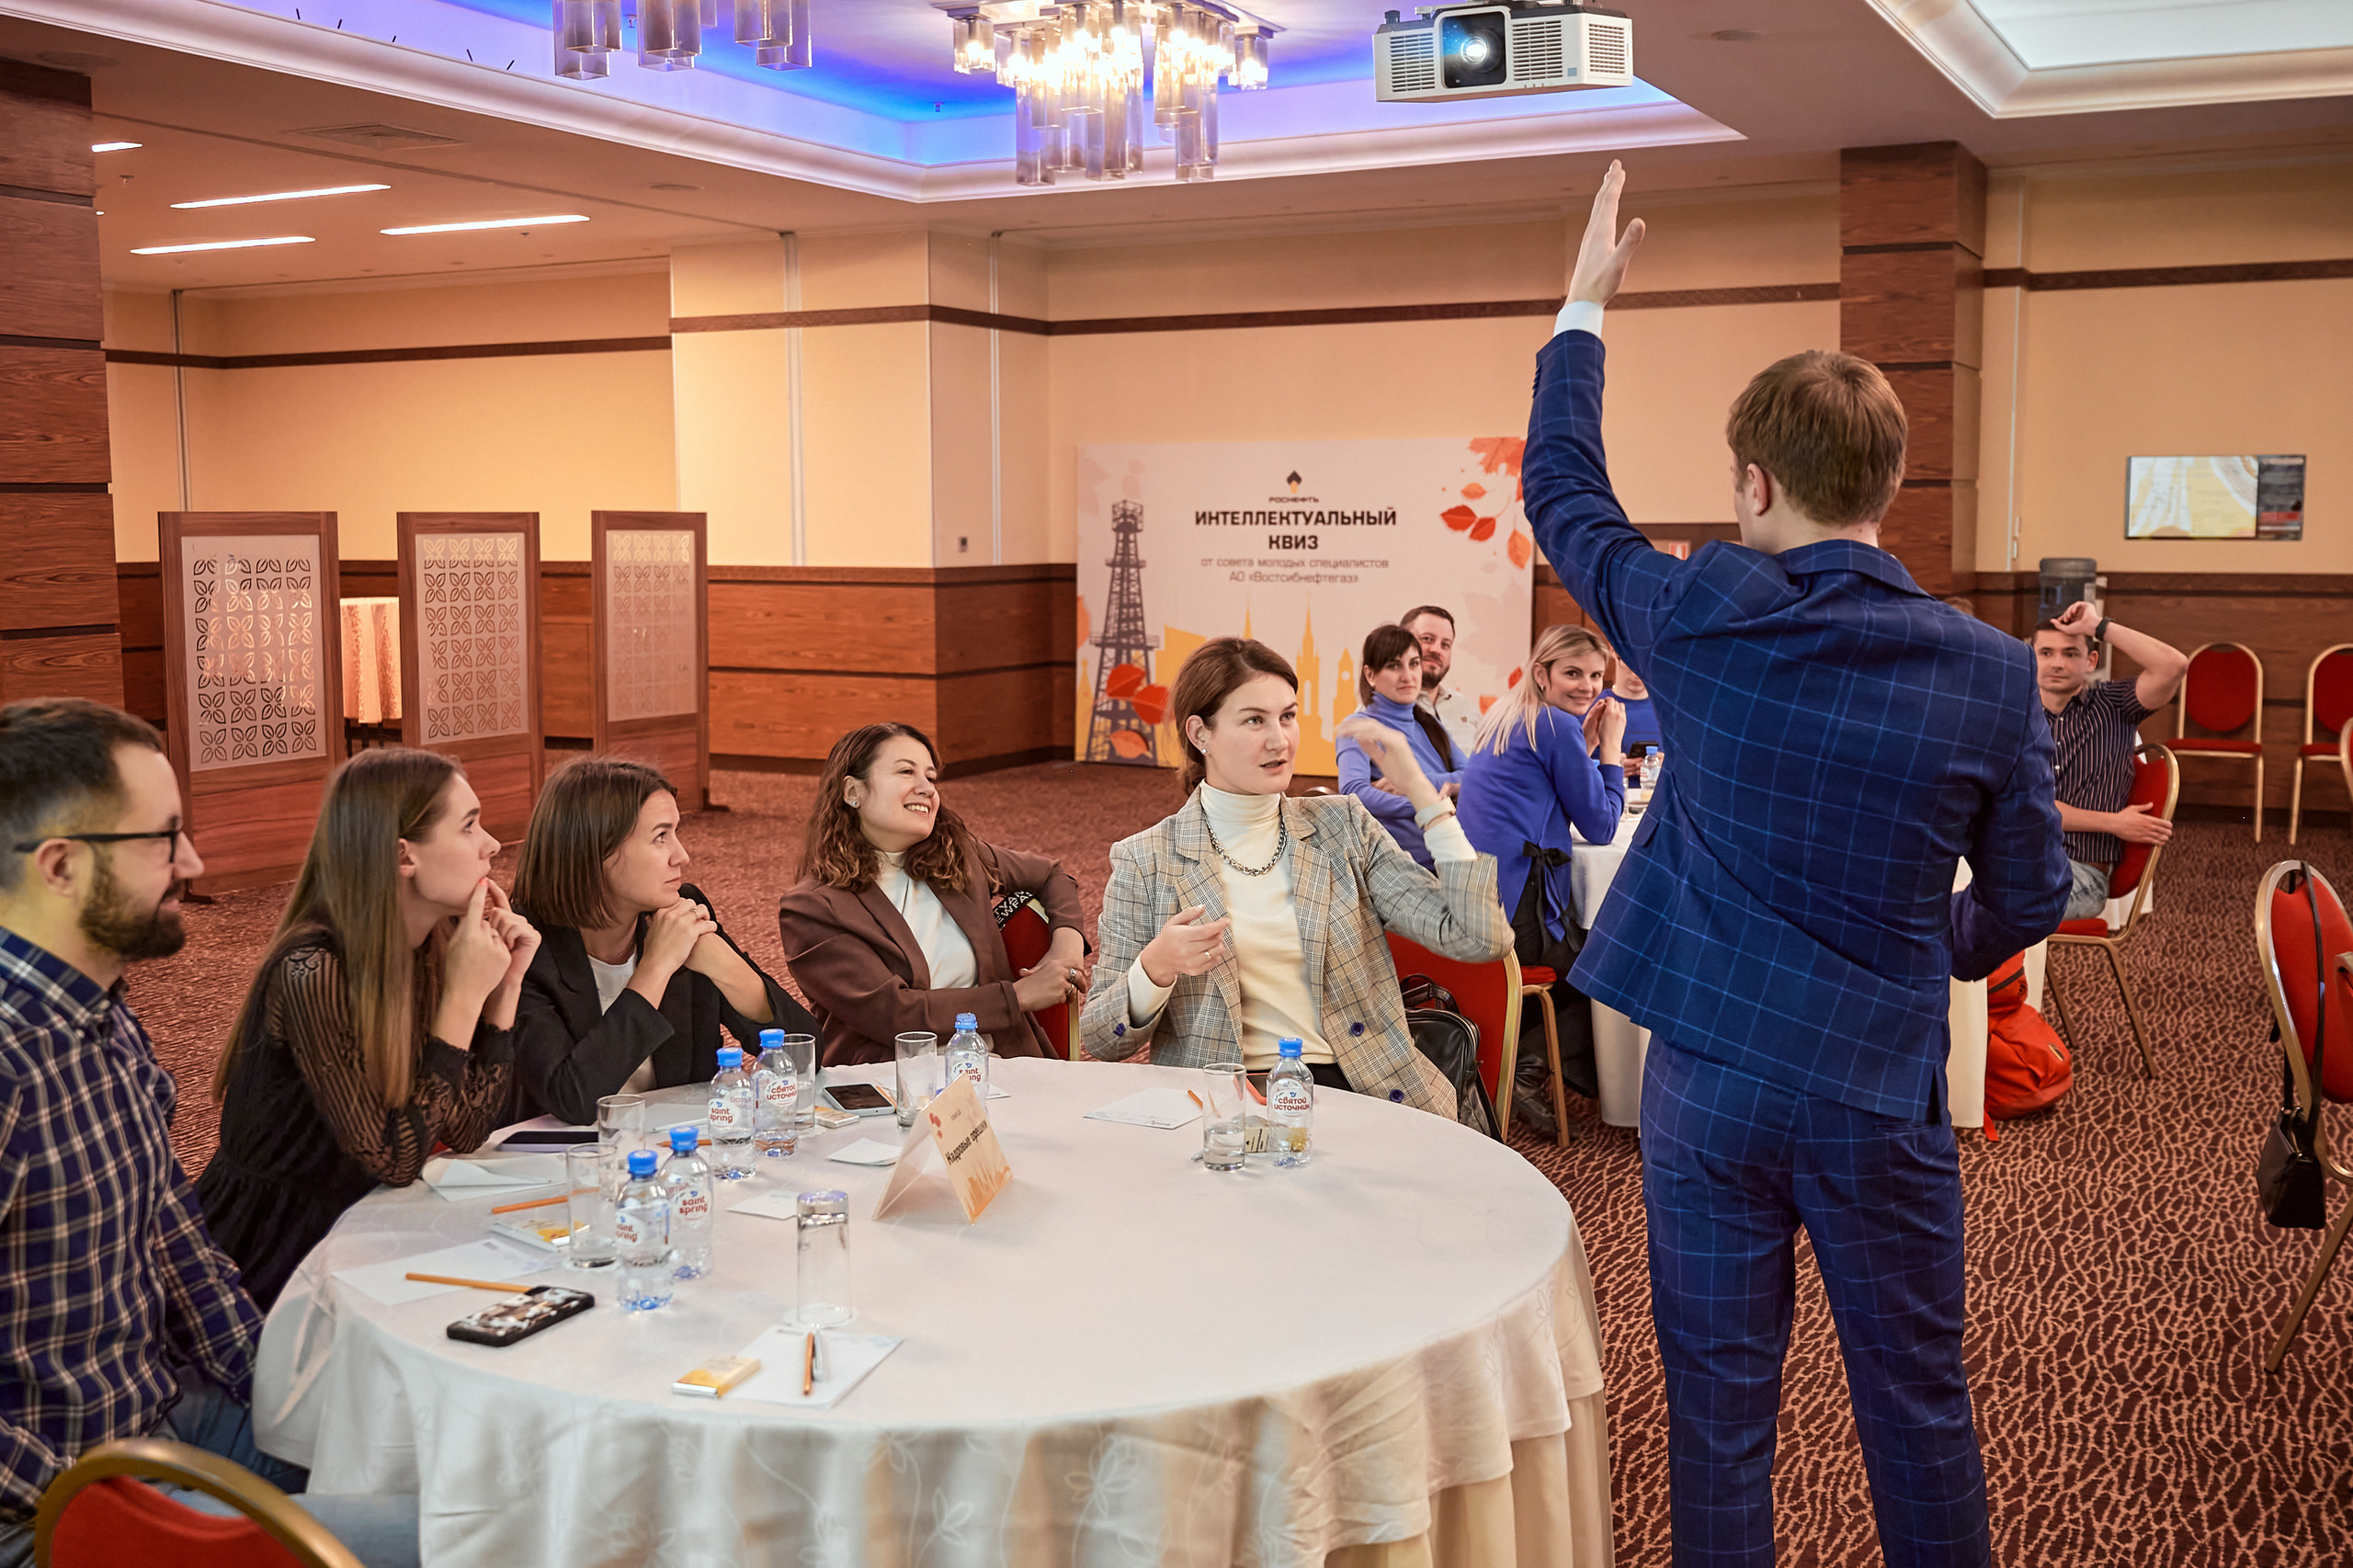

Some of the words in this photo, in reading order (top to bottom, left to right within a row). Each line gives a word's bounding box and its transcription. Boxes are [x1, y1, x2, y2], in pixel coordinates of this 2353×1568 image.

[1195, 506, 1396, 526] ИНТЕЛЛЕКТУАЛЬНЫЙ
[1268, 535, 1318, 550] КВИЗ
[1201, 558, 1212, 567] от
[1217, 558, 1254, 567] совета
[1257, 559, 1305, 569] молодых
[1309, 559, 1389, 569] специалистов
[1229, 572, 1245, 582] АО
[1278, 1096, 1307, 1105] святой
[711, 1107, 731, 1115] saint
[710, 1113, 733, 1123] spring
[682, 1196, 705, 1206] saint
[679, 1203, 708, 1216] spring
